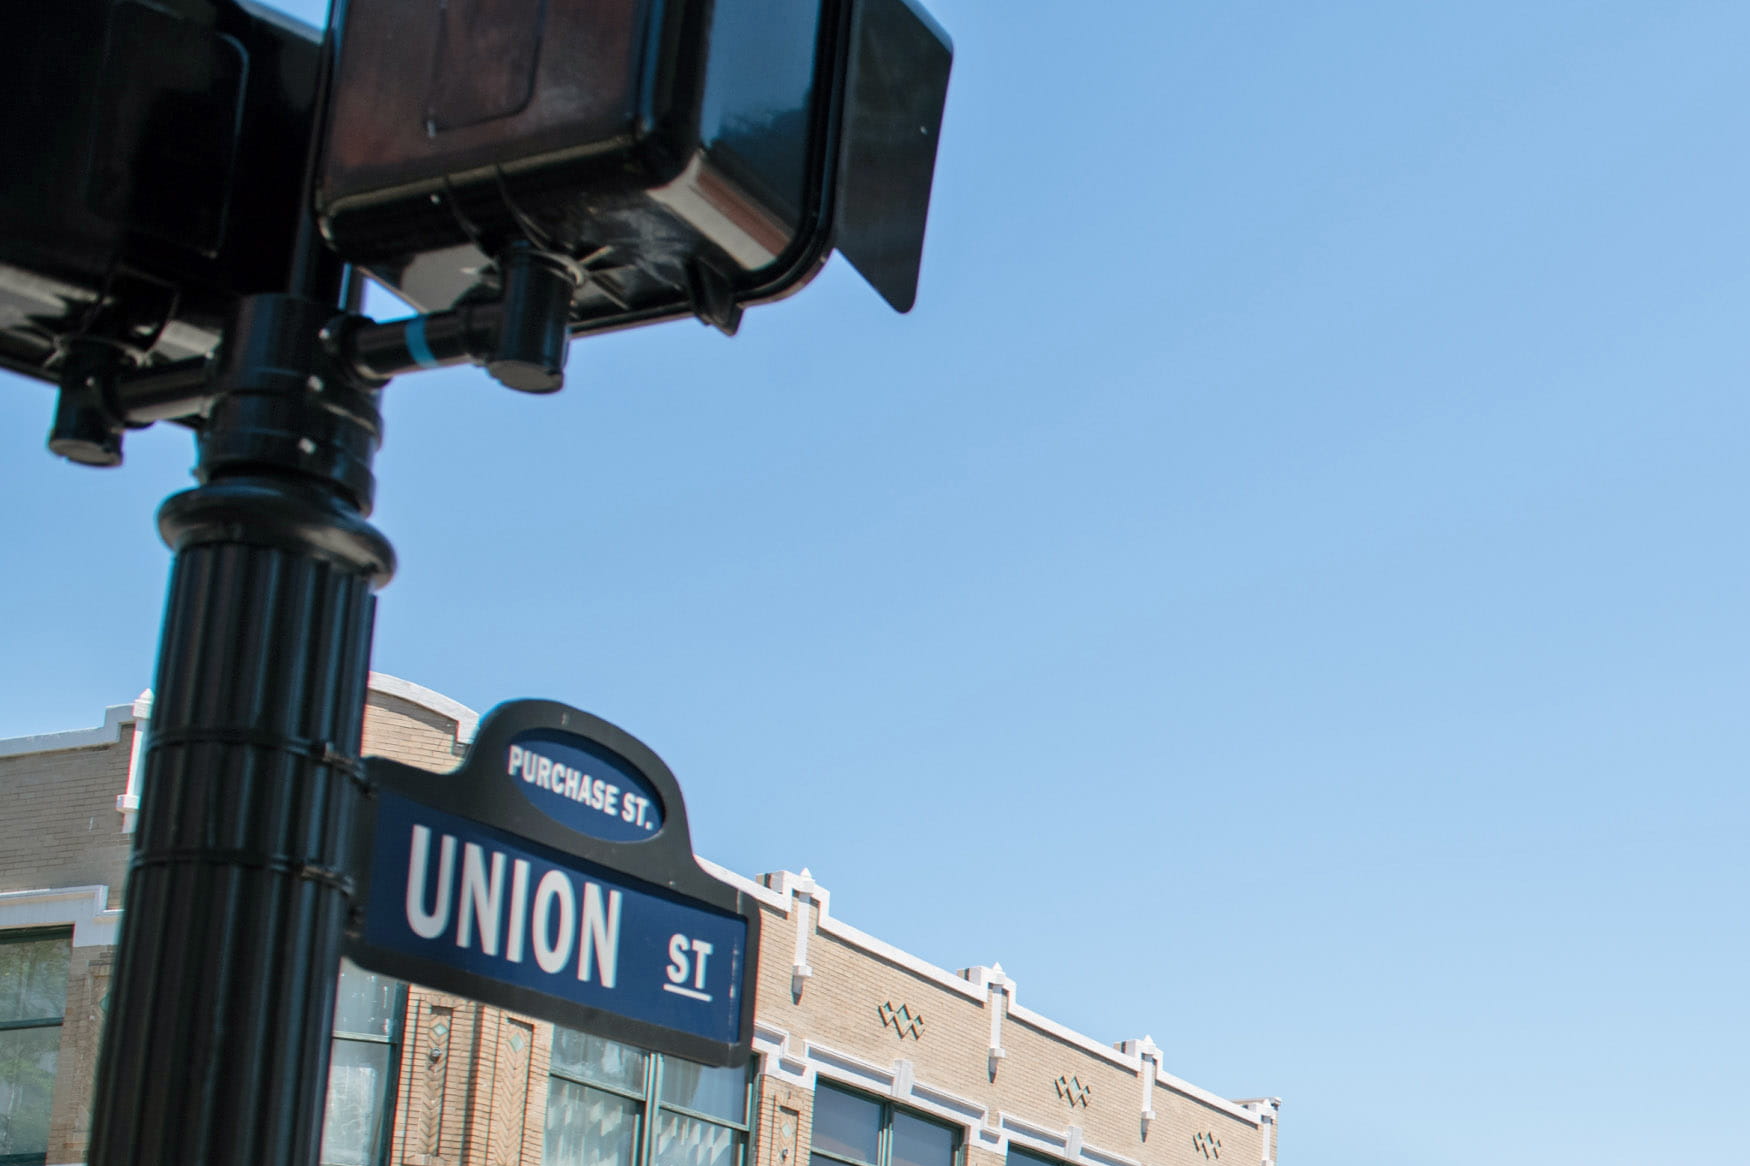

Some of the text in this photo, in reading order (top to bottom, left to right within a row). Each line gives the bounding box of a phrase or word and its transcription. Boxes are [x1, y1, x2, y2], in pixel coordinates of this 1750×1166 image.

[508, 744, 654, 831] PURCHASE ST.
[405, 823, 714, 989] UNION ST
